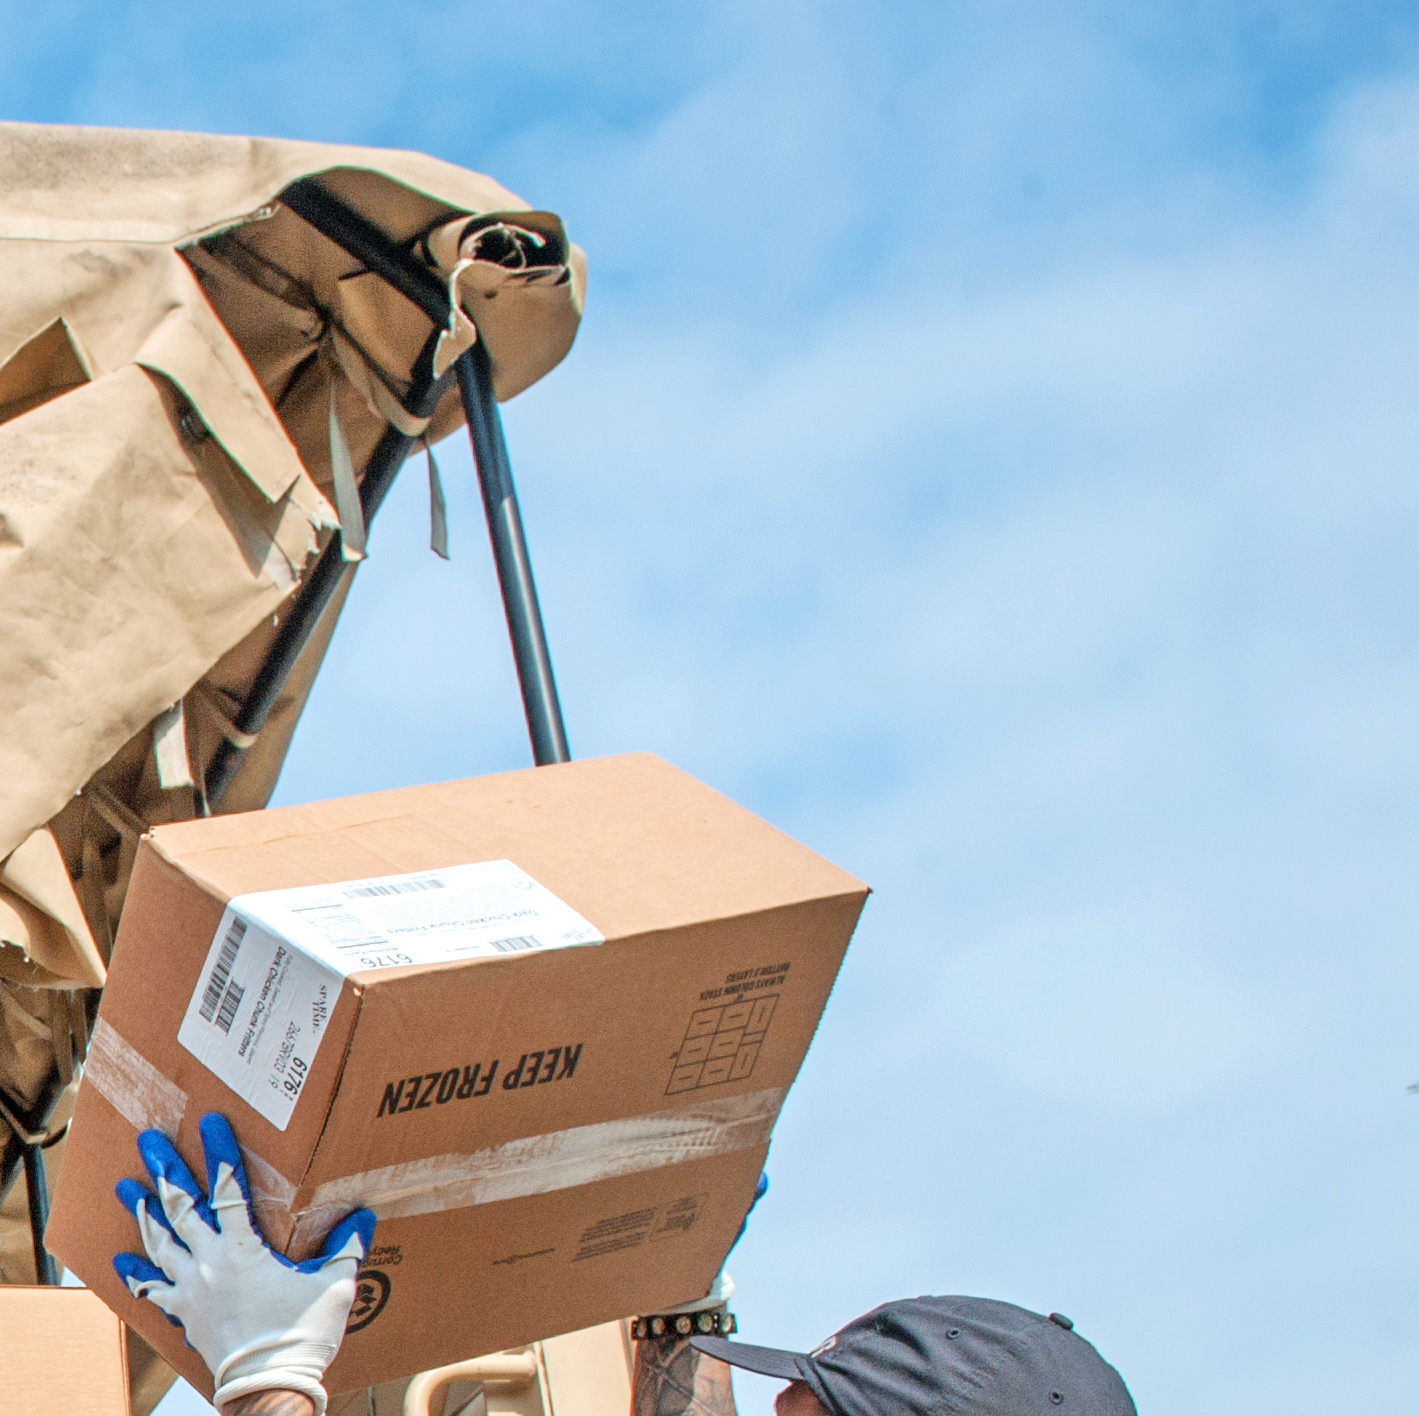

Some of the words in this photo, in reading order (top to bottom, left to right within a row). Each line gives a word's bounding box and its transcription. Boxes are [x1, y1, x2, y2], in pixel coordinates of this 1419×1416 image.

[272, 945, 286, 968] Dark
[359, 953, 413, 968] 6176
[259, 966, 278, 1002] Chicken
[248, 999, 265, 1029] Chunk
[236, 1026, 254, 1058] Fritters
[283, 1055, 307, 1095] 6176
[502, 1043, 584, 1091] KEEP
[376, 1059, 499, 1118] FROZEN
